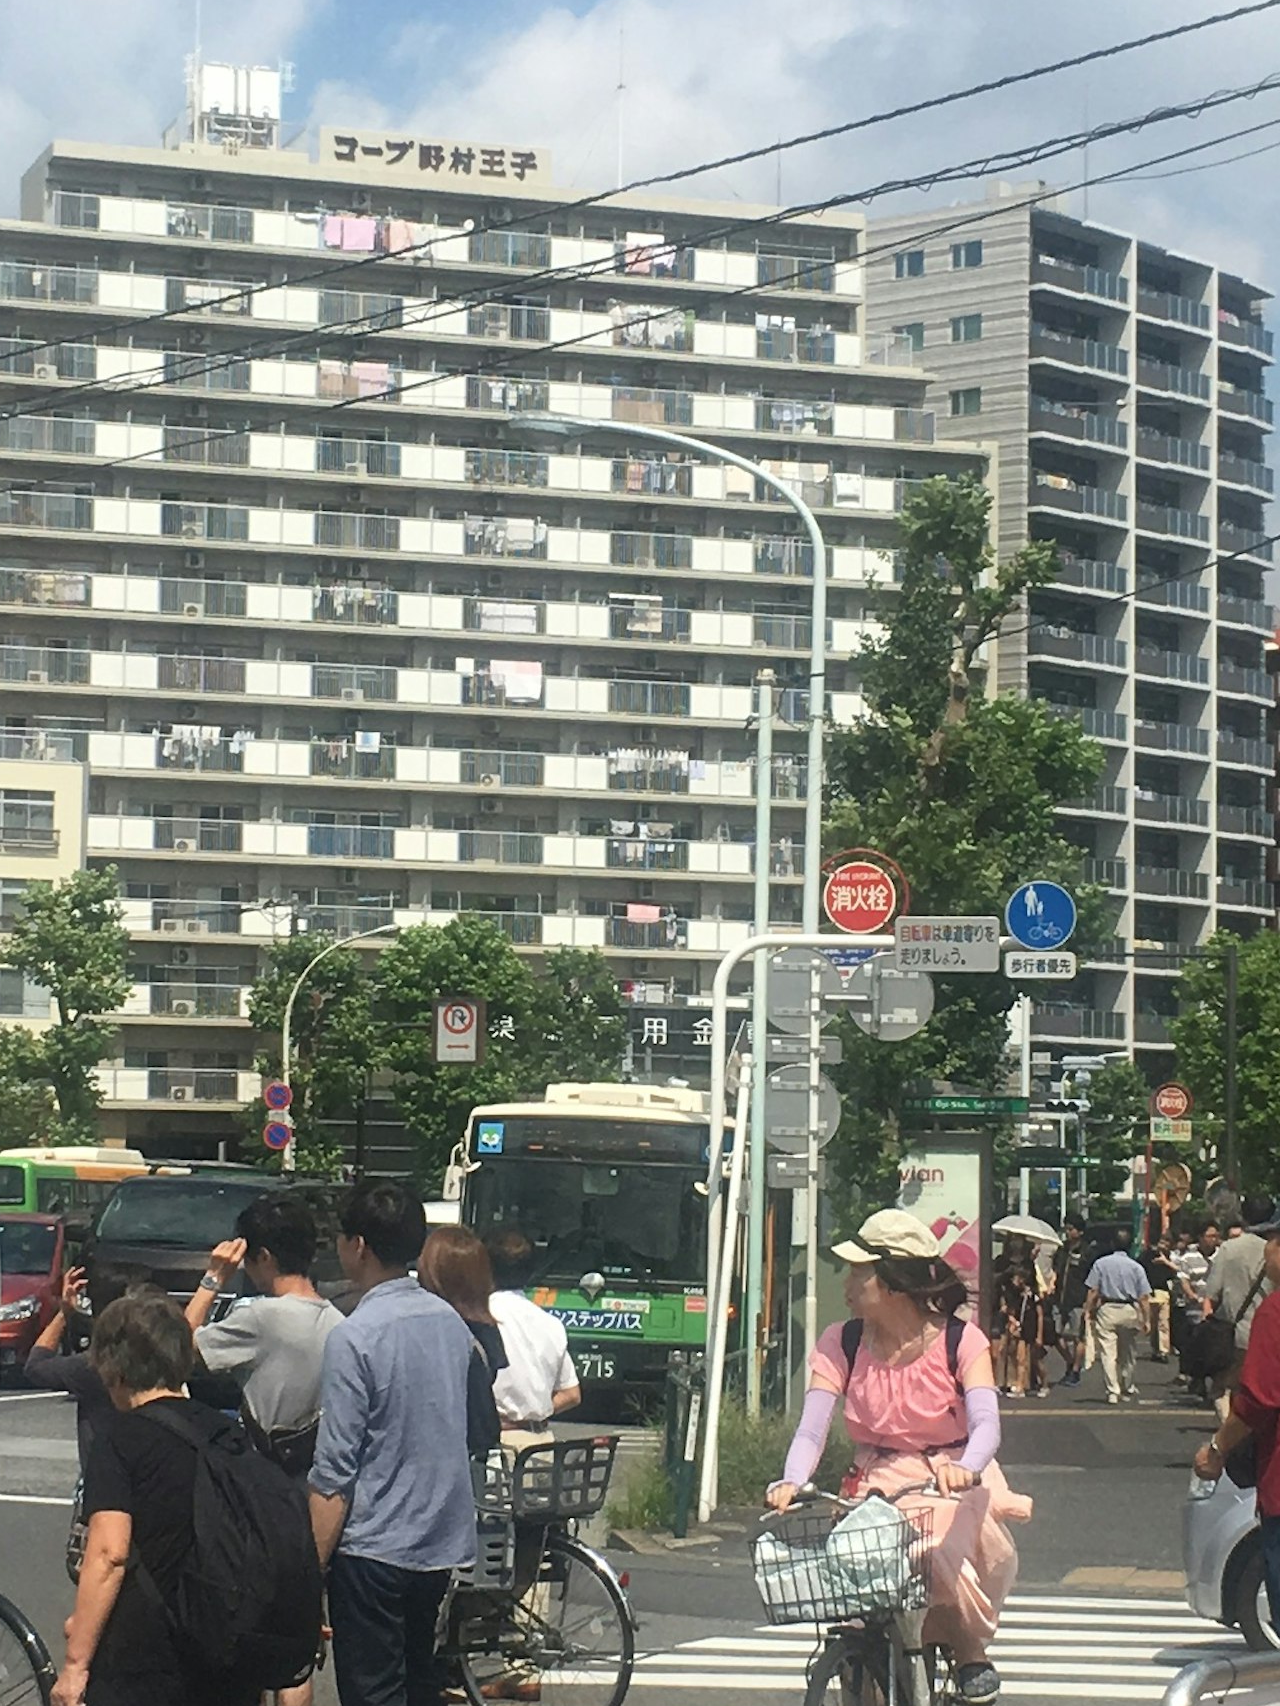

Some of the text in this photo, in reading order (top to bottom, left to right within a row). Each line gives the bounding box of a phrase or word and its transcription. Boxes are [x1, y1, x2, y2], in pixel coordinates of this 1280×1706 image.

[334, 135, 538, 181] コープ野村王子
[831, 884, 889, 911] 消火栓
[899, 924, 995, 944] 自転車は車道寄りを
[899, 948, 967, 967] 走りましょう。
[1011, 957, 1071, 974] 歩行者優先
[899, 1165, 945, 1183] vian
